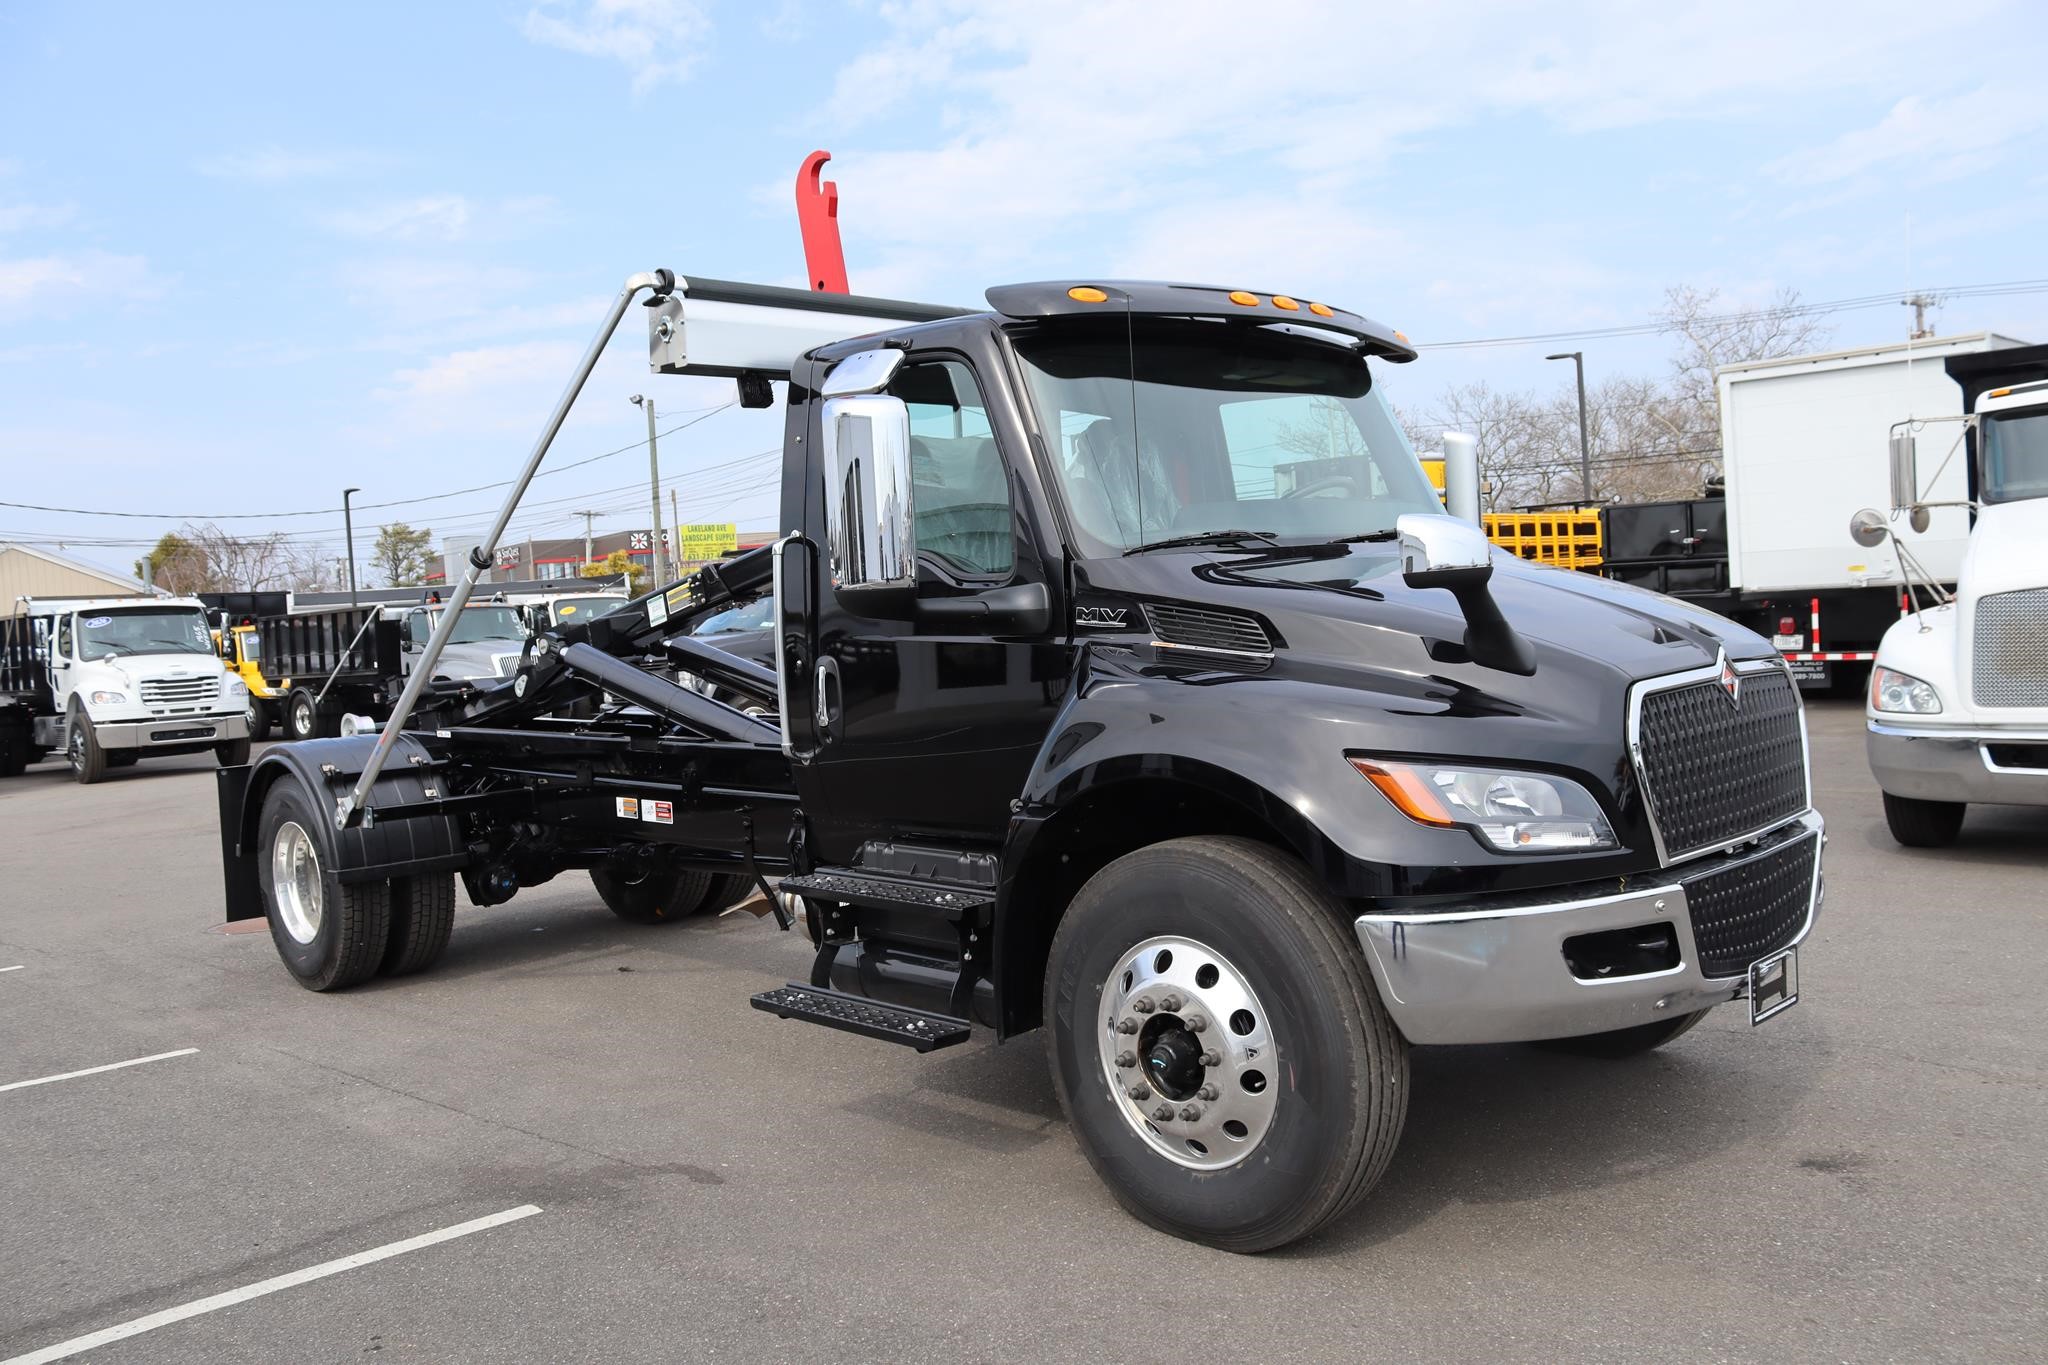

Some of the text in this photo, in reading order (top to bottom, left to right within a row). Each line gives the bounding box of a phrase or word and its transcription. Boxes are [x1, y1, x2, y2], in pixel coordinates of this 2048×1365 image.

[688, 523, 727, 532] LAKELAND AVE
[682, 533, 735, 542] LANDSCAPE SUPPLY
[1075, 606, 1127, 623] MV
